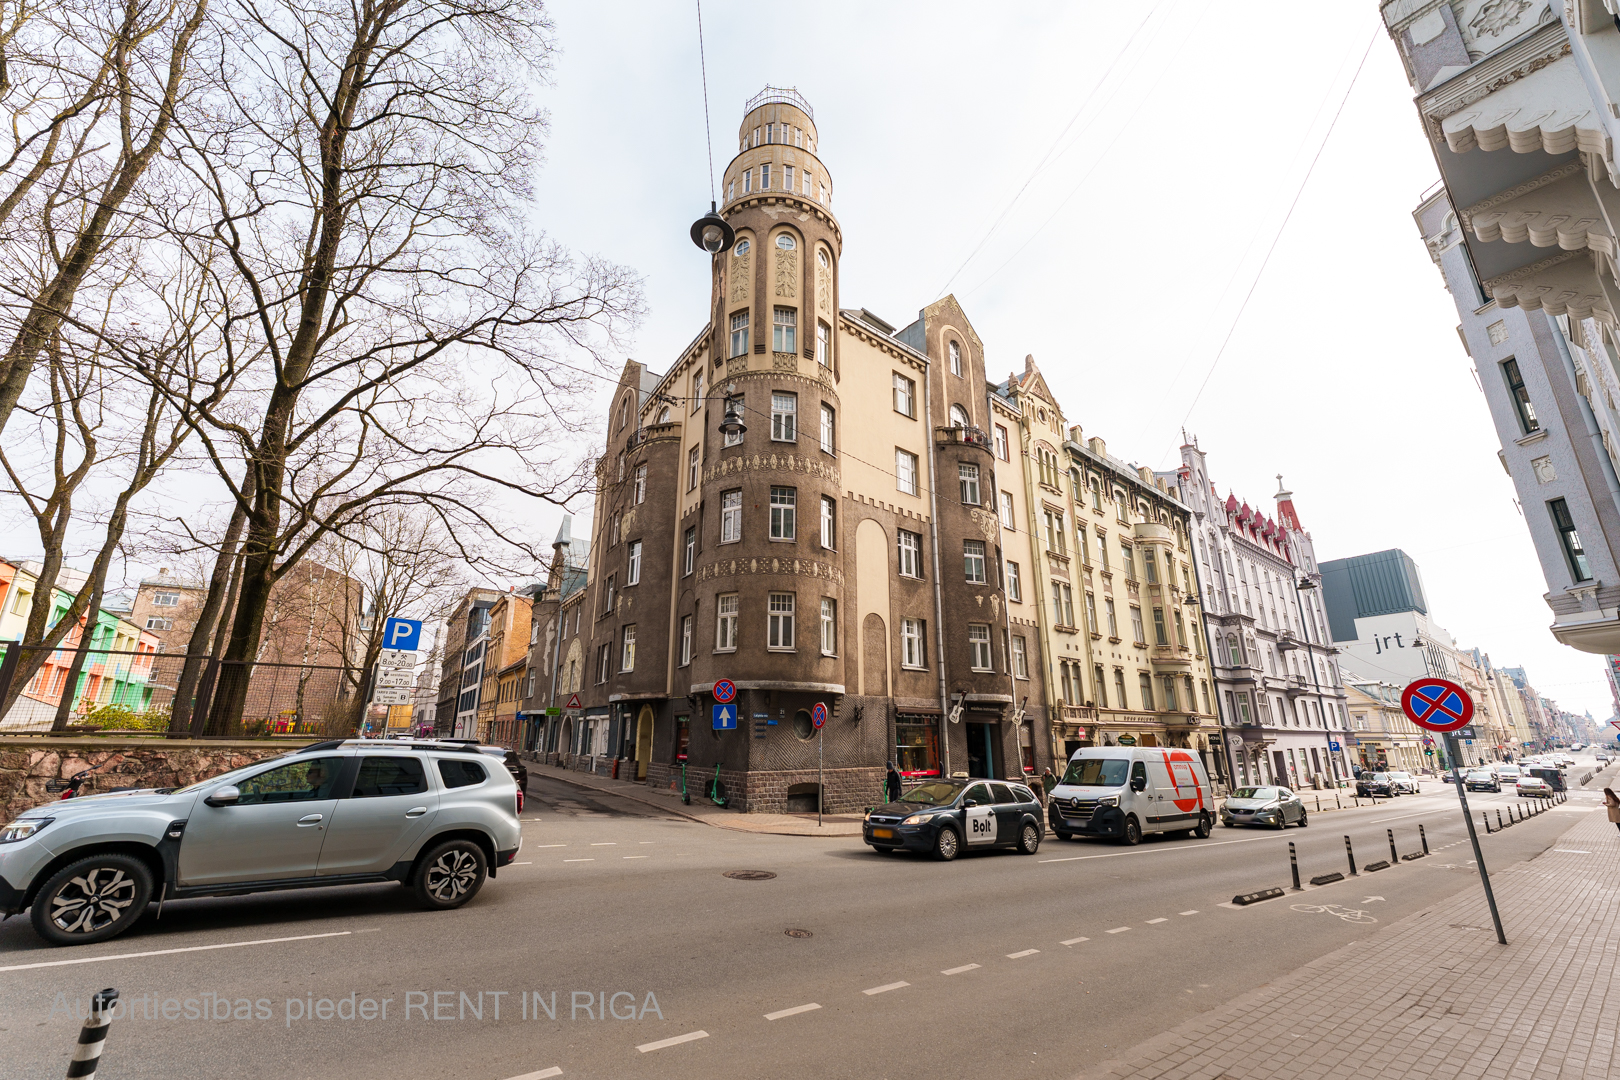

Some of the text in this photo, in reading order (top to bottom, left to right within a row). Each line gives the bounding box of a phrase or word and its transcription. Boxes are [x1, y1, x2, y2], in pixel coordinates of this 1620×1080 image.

[391, 622, 413, 645] P
[1374, 632, 1405, 654] jrt
[973, 819, 991, 836] Bolt
